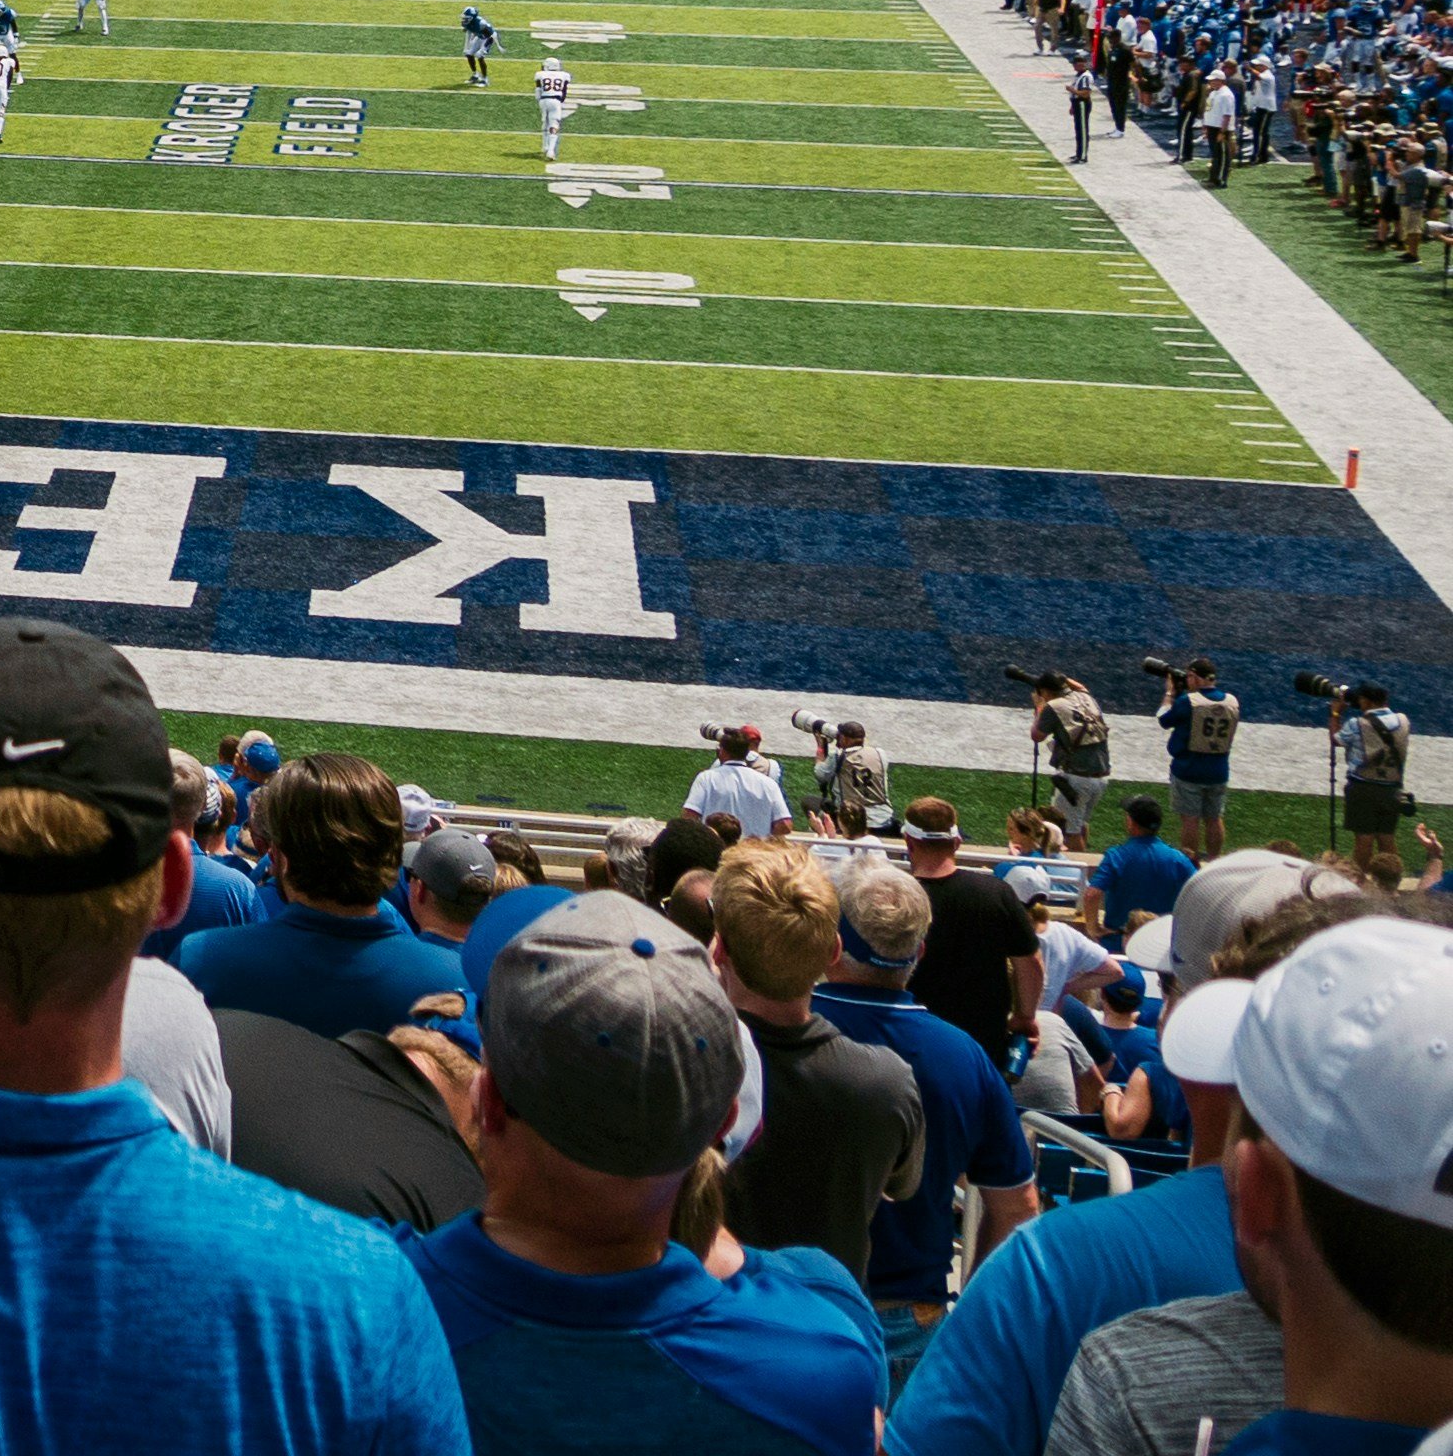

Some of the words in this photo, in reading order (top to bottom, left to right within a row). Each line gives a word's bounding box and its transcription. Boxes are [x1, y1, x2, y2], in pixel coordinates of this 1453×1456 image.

[542, 78, 562, 92] 88
[148, 84, 256, 164] KROGER
[273, 96, 366, 158] FIELD
[1202, 717, 1230, 738] 62
